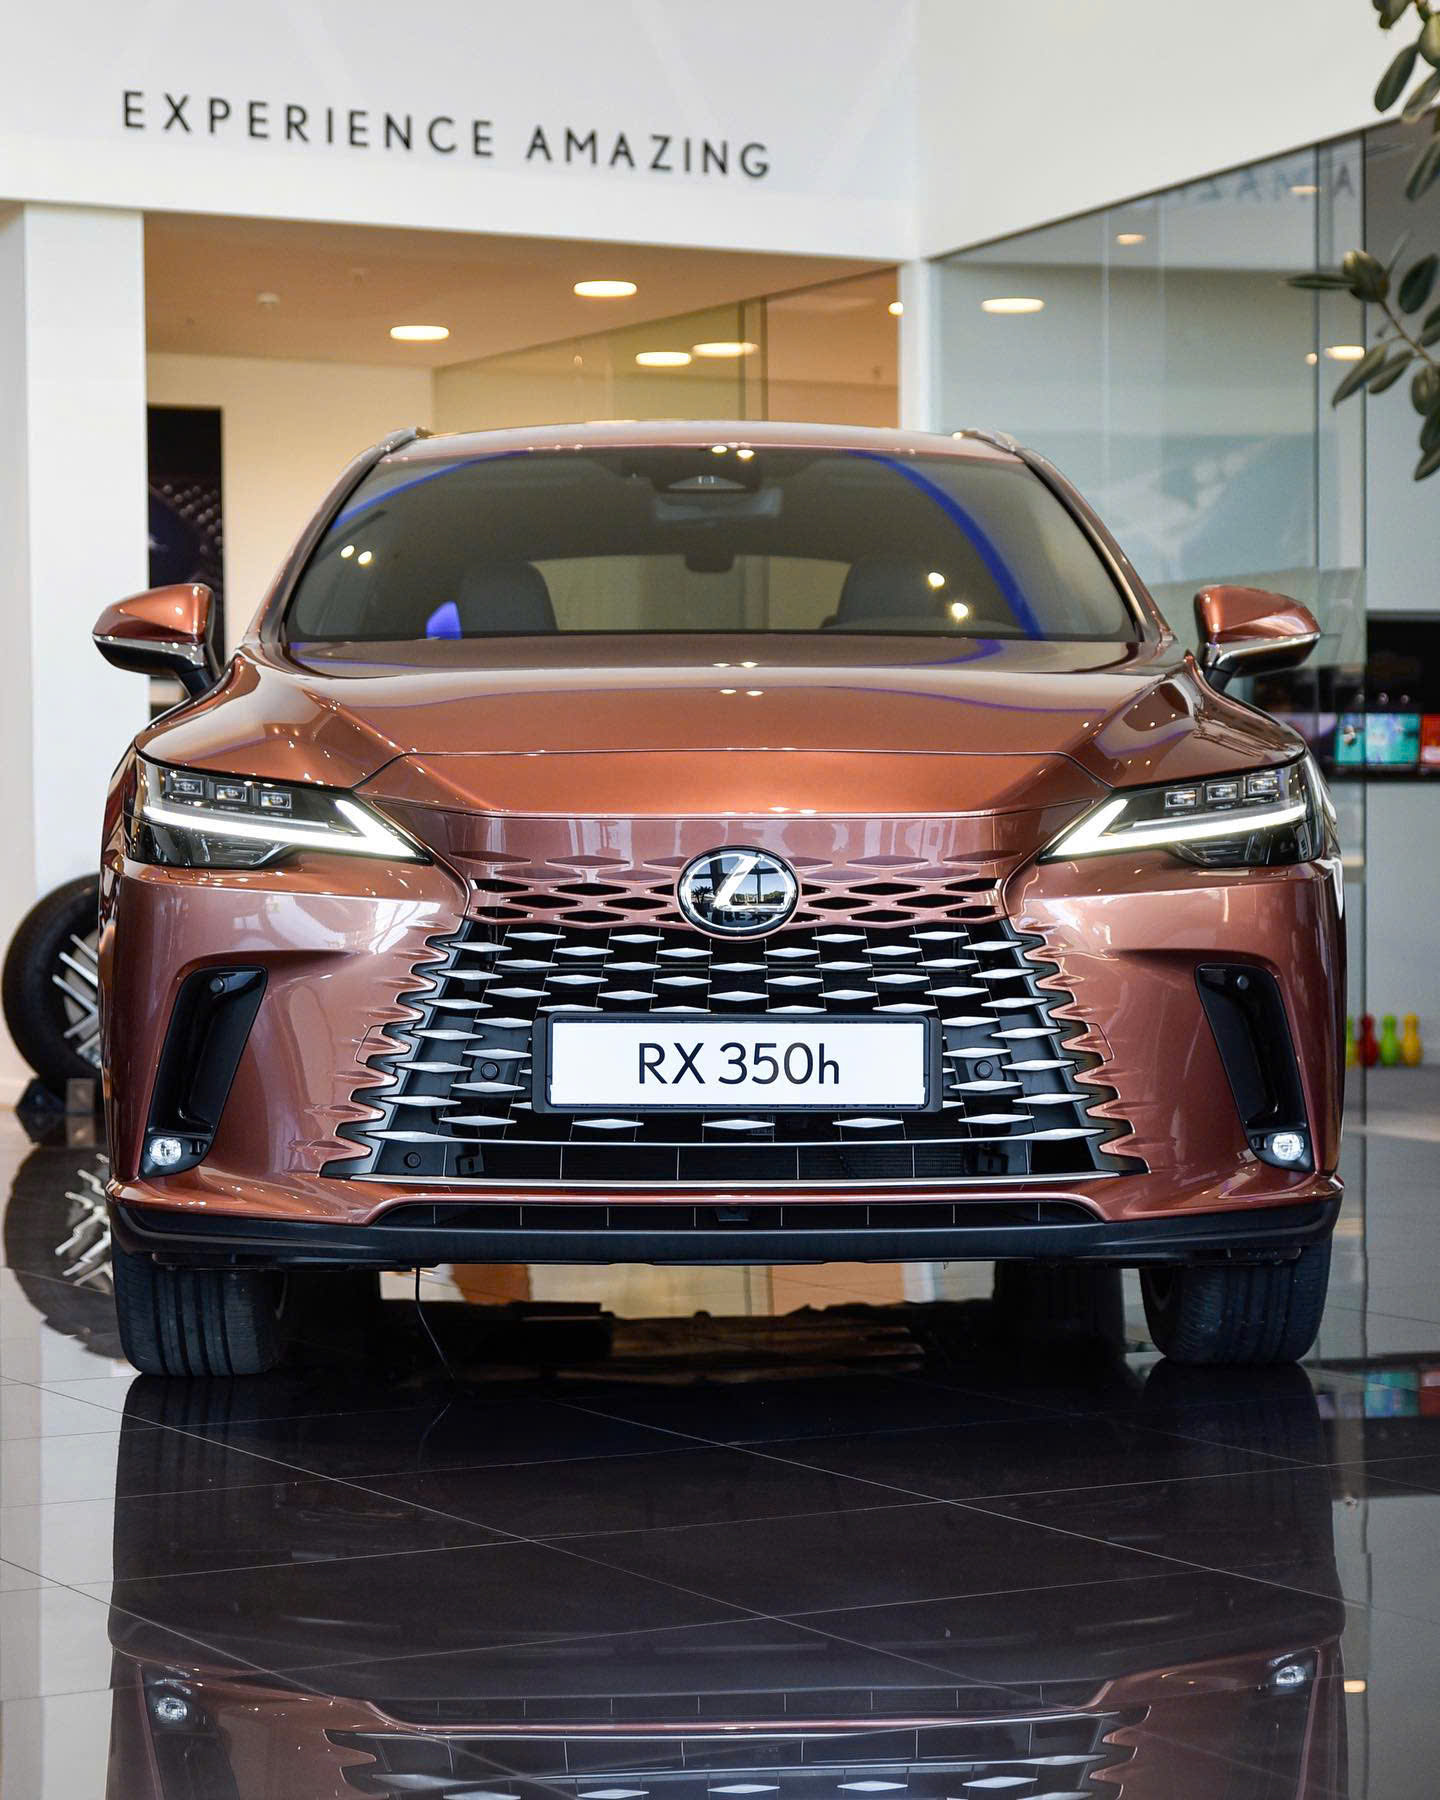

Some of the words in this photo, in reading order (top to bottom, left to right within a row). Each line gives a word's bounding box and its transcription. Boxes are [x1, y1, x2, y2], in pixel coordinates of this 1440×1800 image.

[123, 90, 493, 157] EXPERIENCE
[526, 126, 769, 179] AMAZING
[638, 1042, 706, 1085] RX
[718, 1041, 840, 1085] 350h
